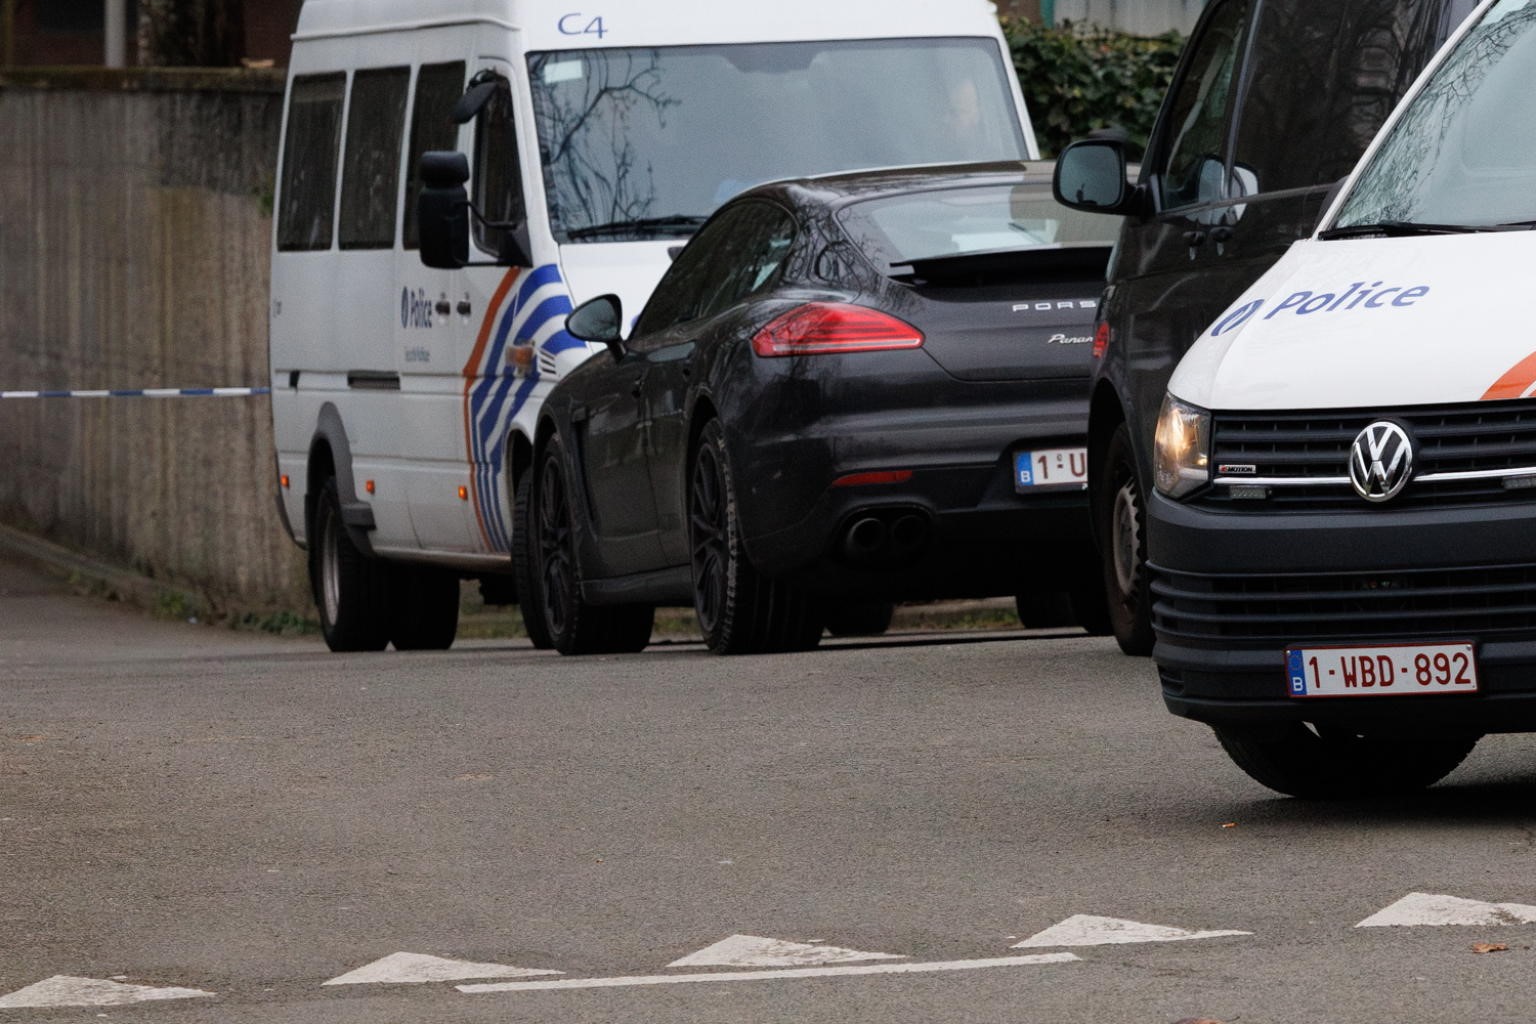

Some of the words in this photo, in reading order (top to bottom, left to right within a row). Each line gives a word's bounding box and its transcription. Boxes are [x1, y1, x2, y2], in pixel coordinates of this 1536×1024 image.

[557, 12, 608, 39] C4
[410, 287, 432, 329] Police
[1263, 280, 1430, 320] Police
[1293, 676, 1303, 692] B
[1309, 651, 1471, 689] 1-WBD-892
